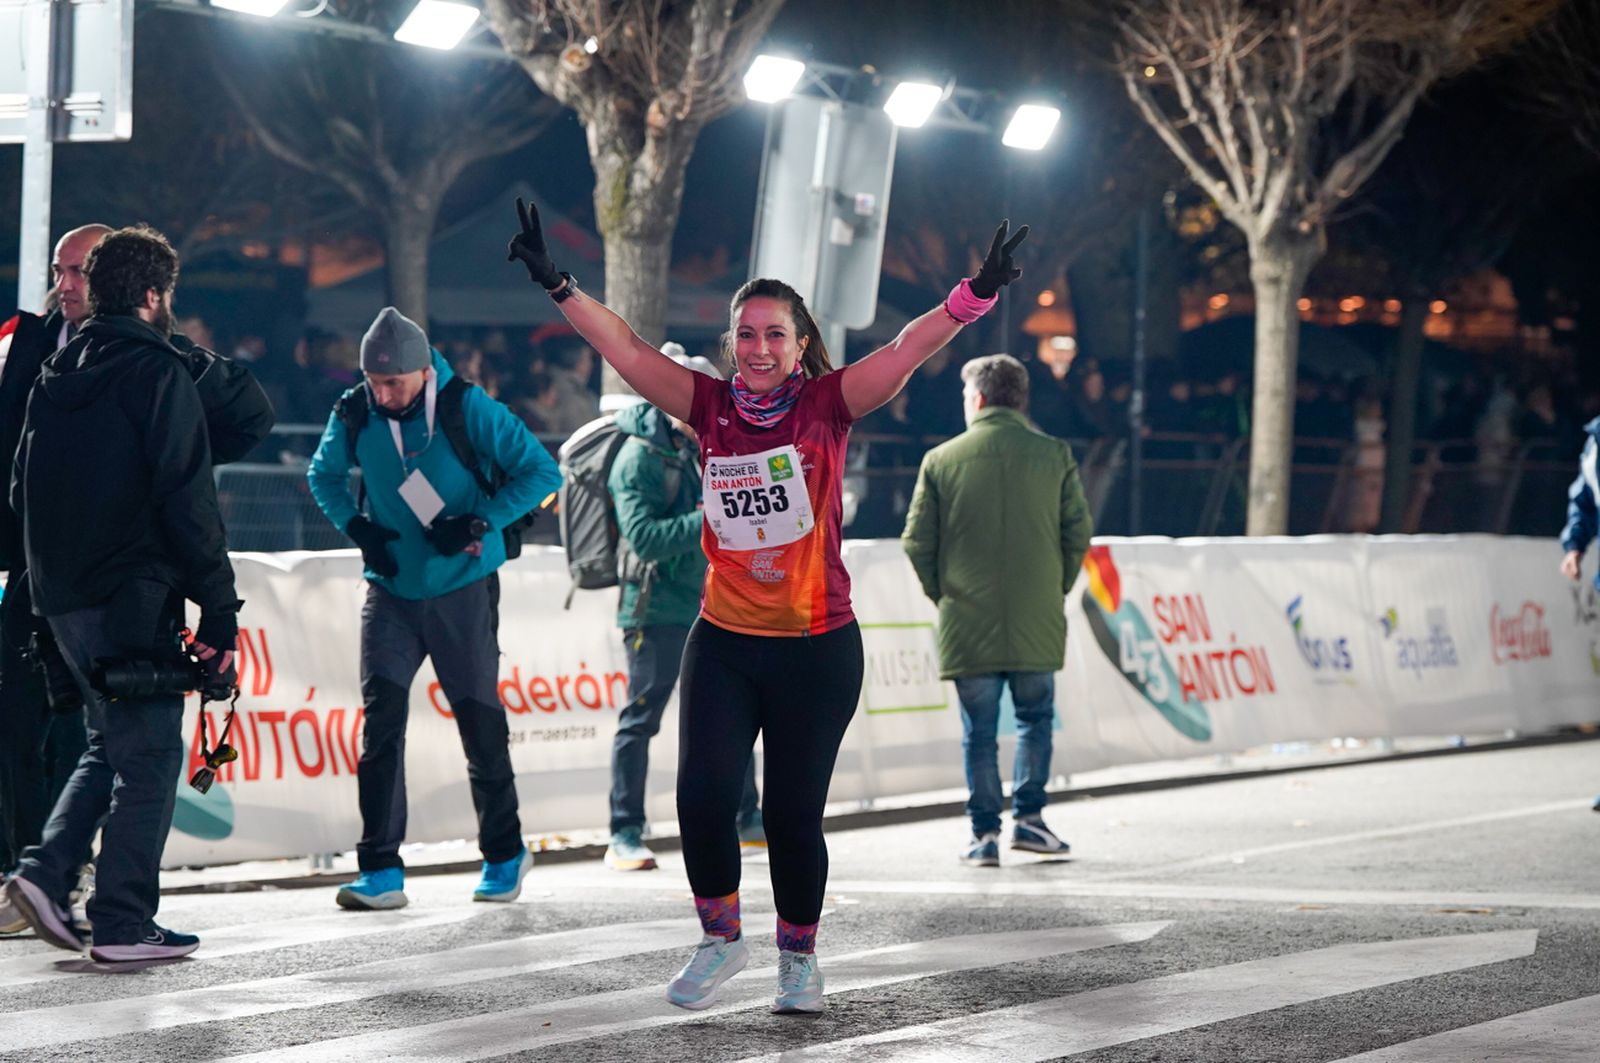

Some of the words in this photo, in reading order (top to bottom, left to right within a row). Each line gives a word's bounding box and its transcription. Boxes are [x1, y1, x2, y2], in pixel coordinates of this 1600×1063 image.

[711, 479, 729, 490] SAN
[719, 465, 746, 477] NOCHE
[748, 464, 760, 475] DE
[720, 484, 790, 518] 5253
[749, 518, 767, 526] Isabel
[1152, 593, 1213, 645] SAN
[1118, 620, 1170, 703] 43
[1178, 632, 1277, 703] ANTÓN
[428, 662, 628, 720] cderón
[187, 686, 365, 784] ANTÓN
[530, 725, 597, 743] maestras
